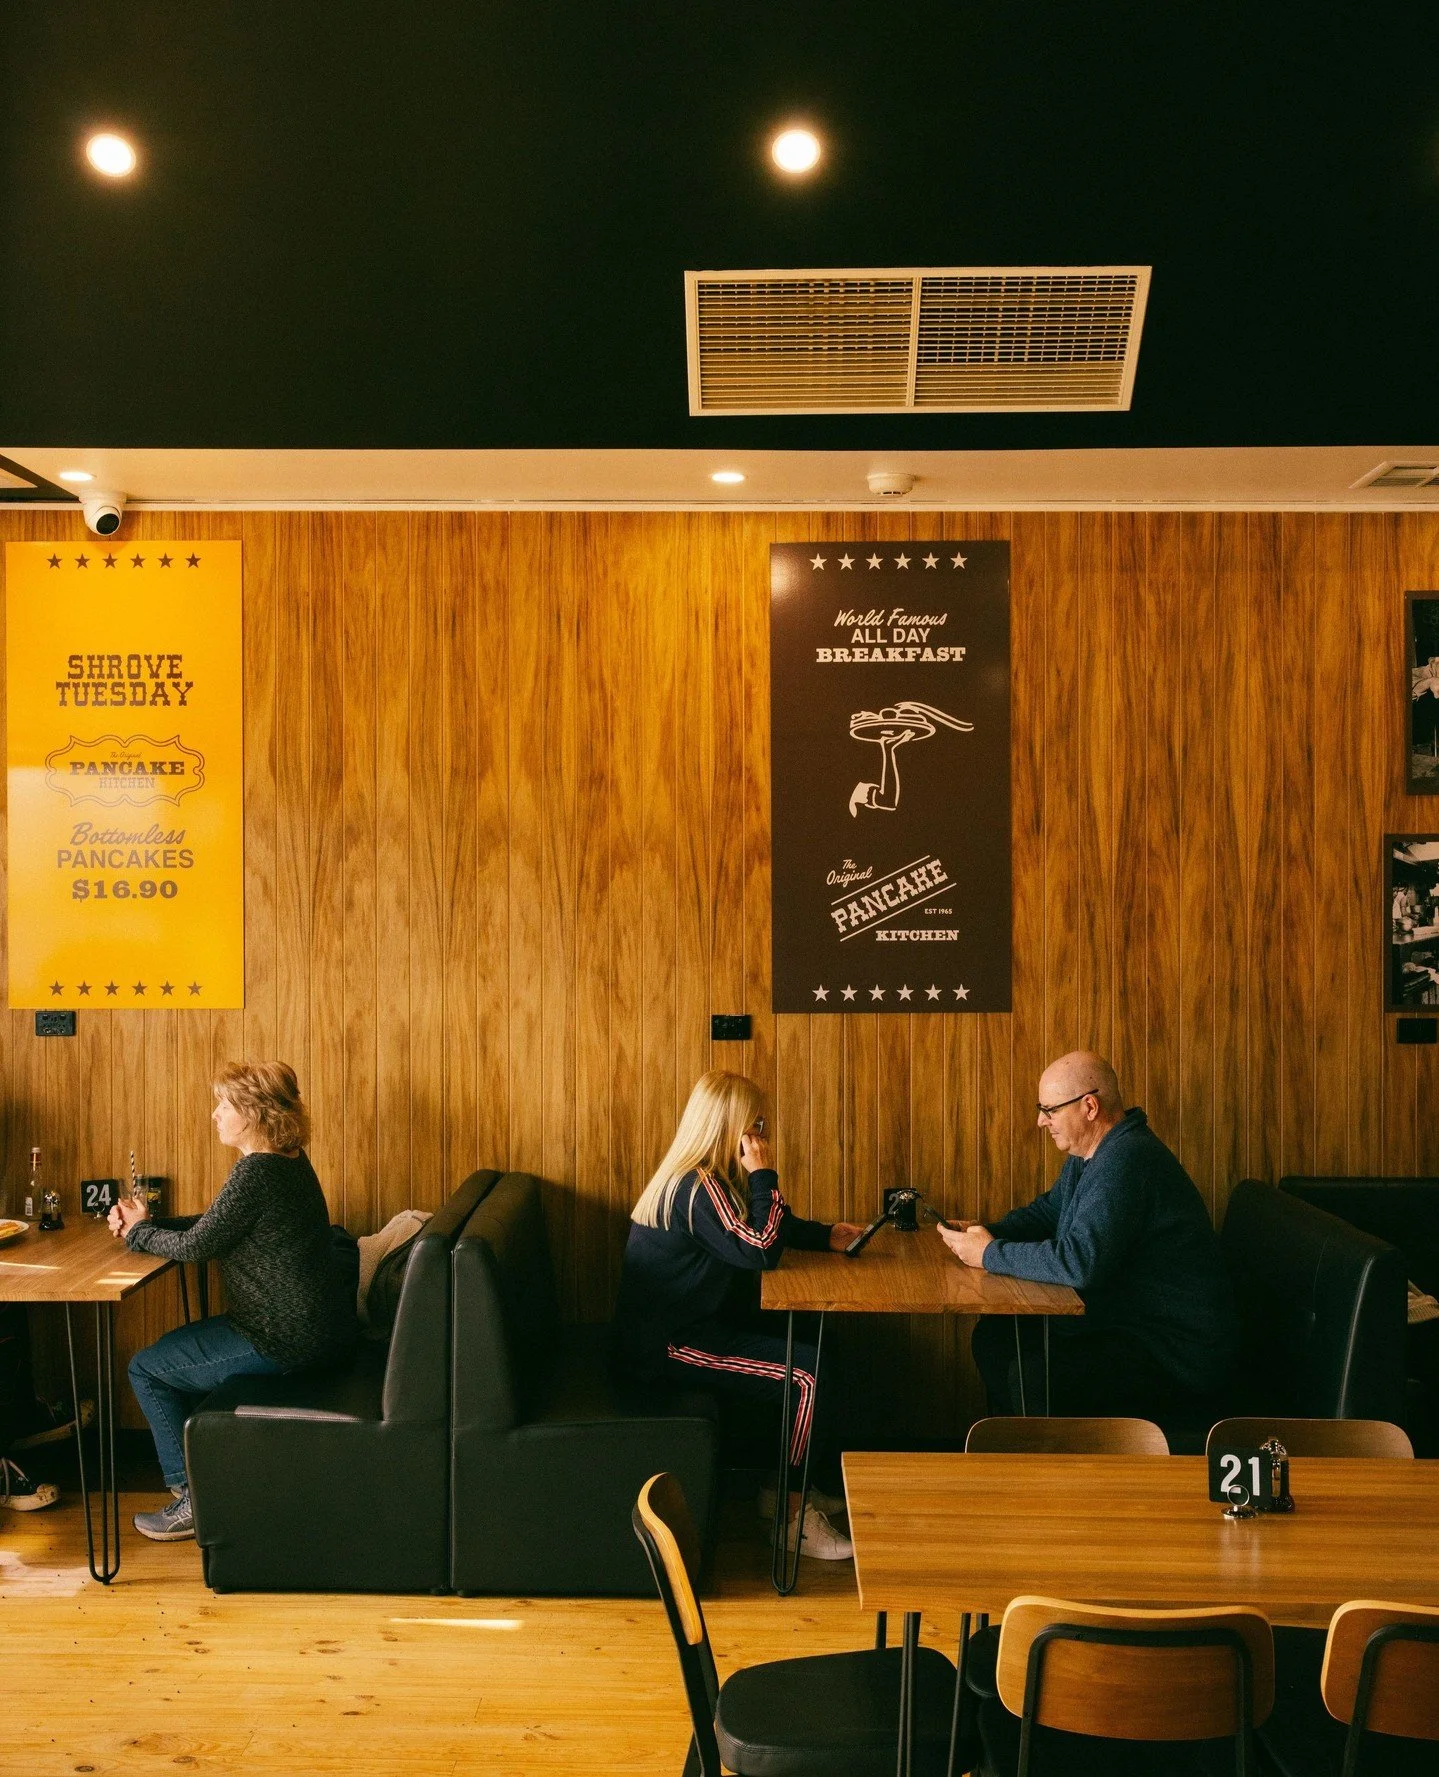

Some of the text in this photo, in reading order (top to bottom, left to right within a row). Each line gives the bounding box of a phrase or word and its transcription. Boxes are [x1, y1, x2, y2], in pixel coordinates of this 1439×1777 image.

[834, 607, 948, 627] World Famous
[851, 628, 931, 644] ALL DAY
[816, 647, 966, 662] BREAKFAST
[67, 654, 183, 679] SHROVE
[56, 681, 194, 706] TUESDAY
[69, 761, 185, 775] PANCAKE
[99, 777, 155, 788] KITCHEN
[70, 821, 186, 845] Bottomless
[57, 849, 194, 868] PANCAKES
[842, 859, 857, 870] The
[826, 866, 873, 888] Original
[72, 878, 178, 902] $16.90
[830, 859, 949, 933] PANCAKE
[875, 930, 960, 941] KITCHEN
[86, 1183, 111, 1207] 24
[1220, 1454, 1260, 1496] 21
